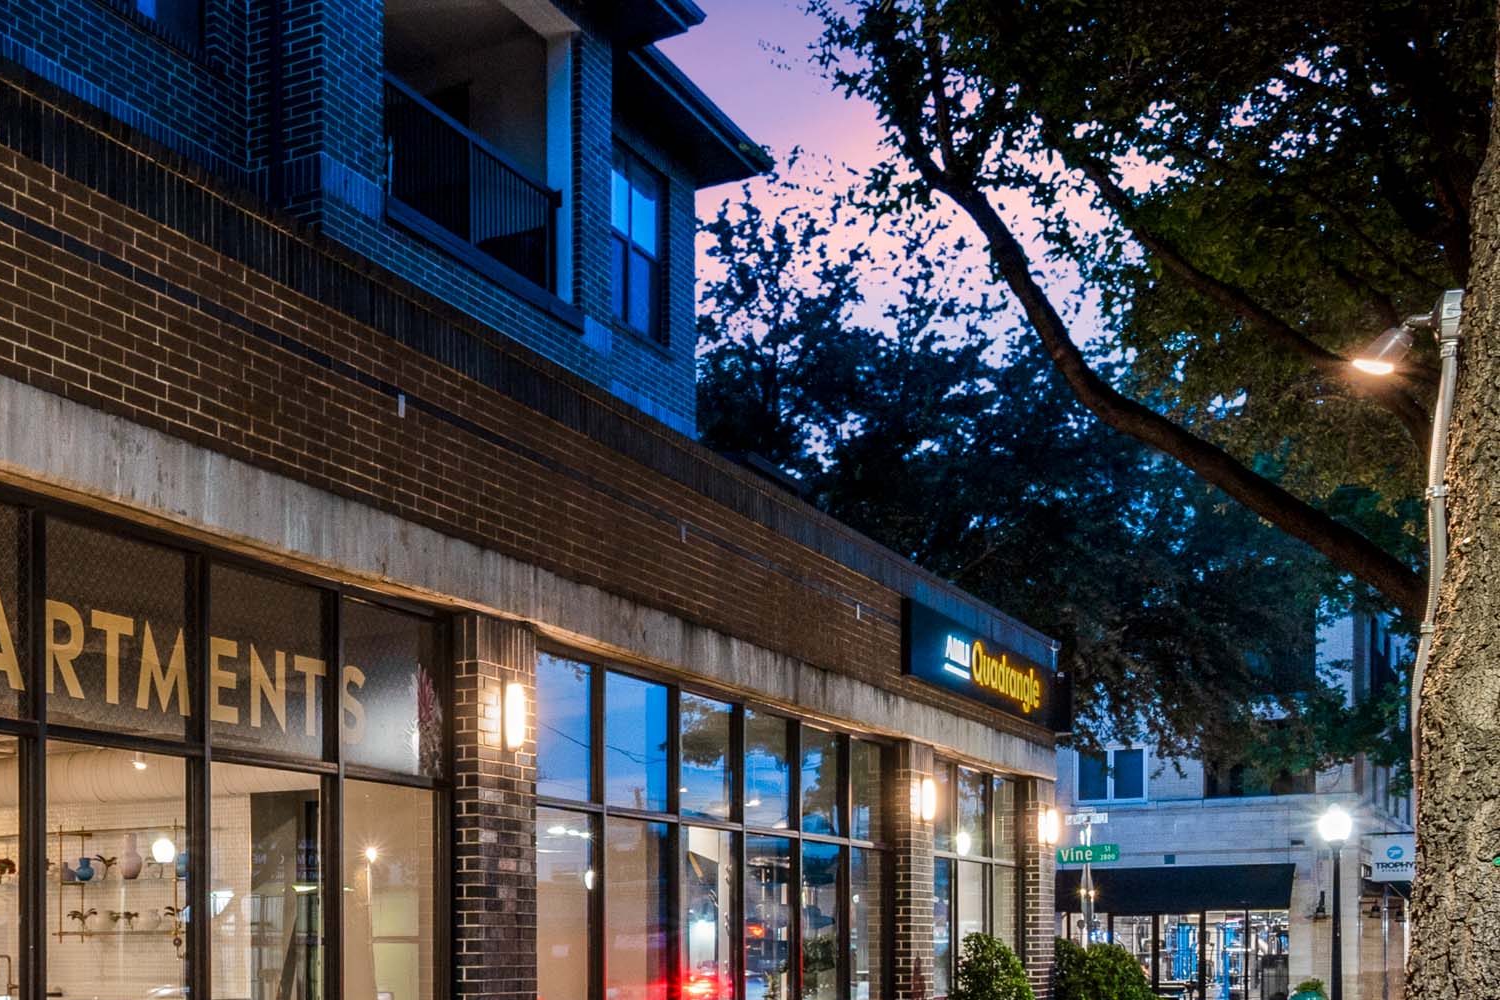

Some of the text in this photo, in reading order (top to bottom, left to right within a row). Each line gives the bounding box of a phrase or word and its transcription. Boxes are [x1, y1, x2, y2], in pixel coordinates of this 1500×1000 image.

[972, 640, 1040, 713] Quadrangle
[1060, 847, 1093, 862] Vine
[1375, 861, 1415, 869] TROPHY
